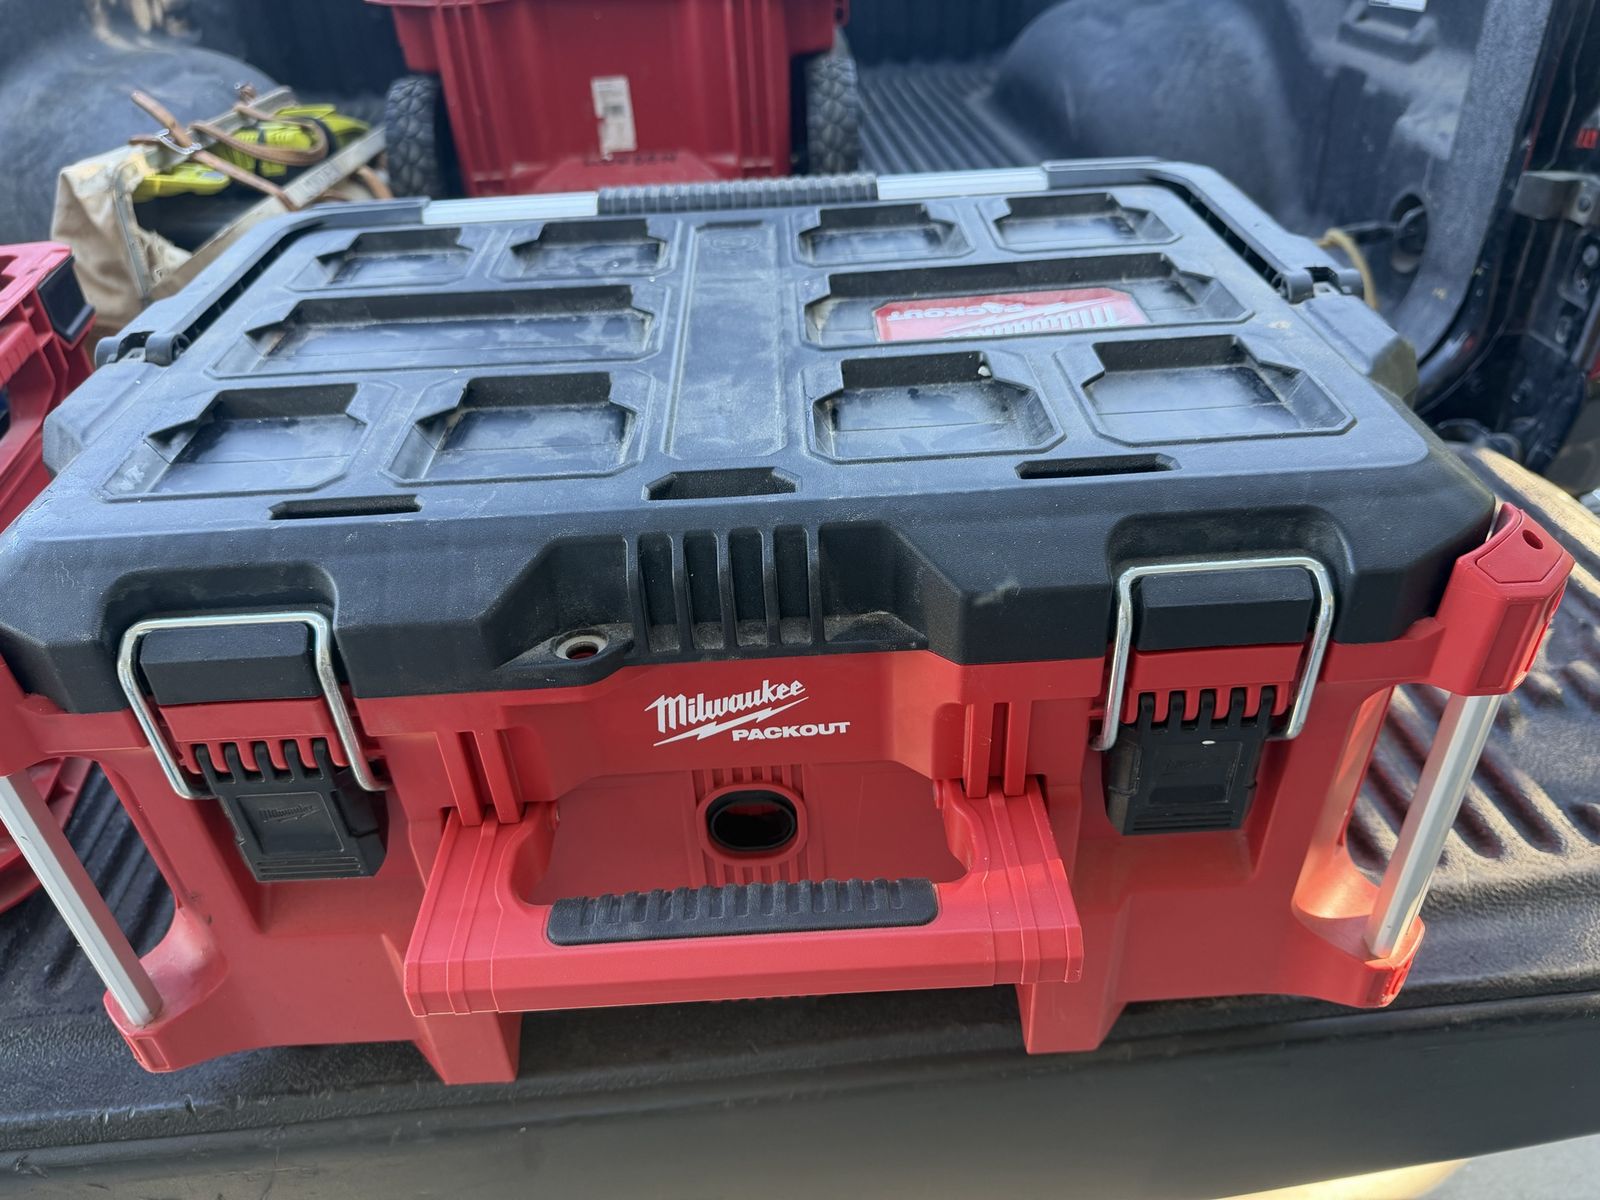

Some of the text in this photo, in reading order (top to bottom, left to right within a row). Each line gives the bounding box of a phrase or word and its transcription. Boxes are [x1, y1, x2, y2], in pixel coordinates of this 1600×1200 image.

[887, 301, 1024, 321] PACKOUT
[644, 679, 806, 733] Milwaukee
[732, 721, 851, 741] PACKOUT
